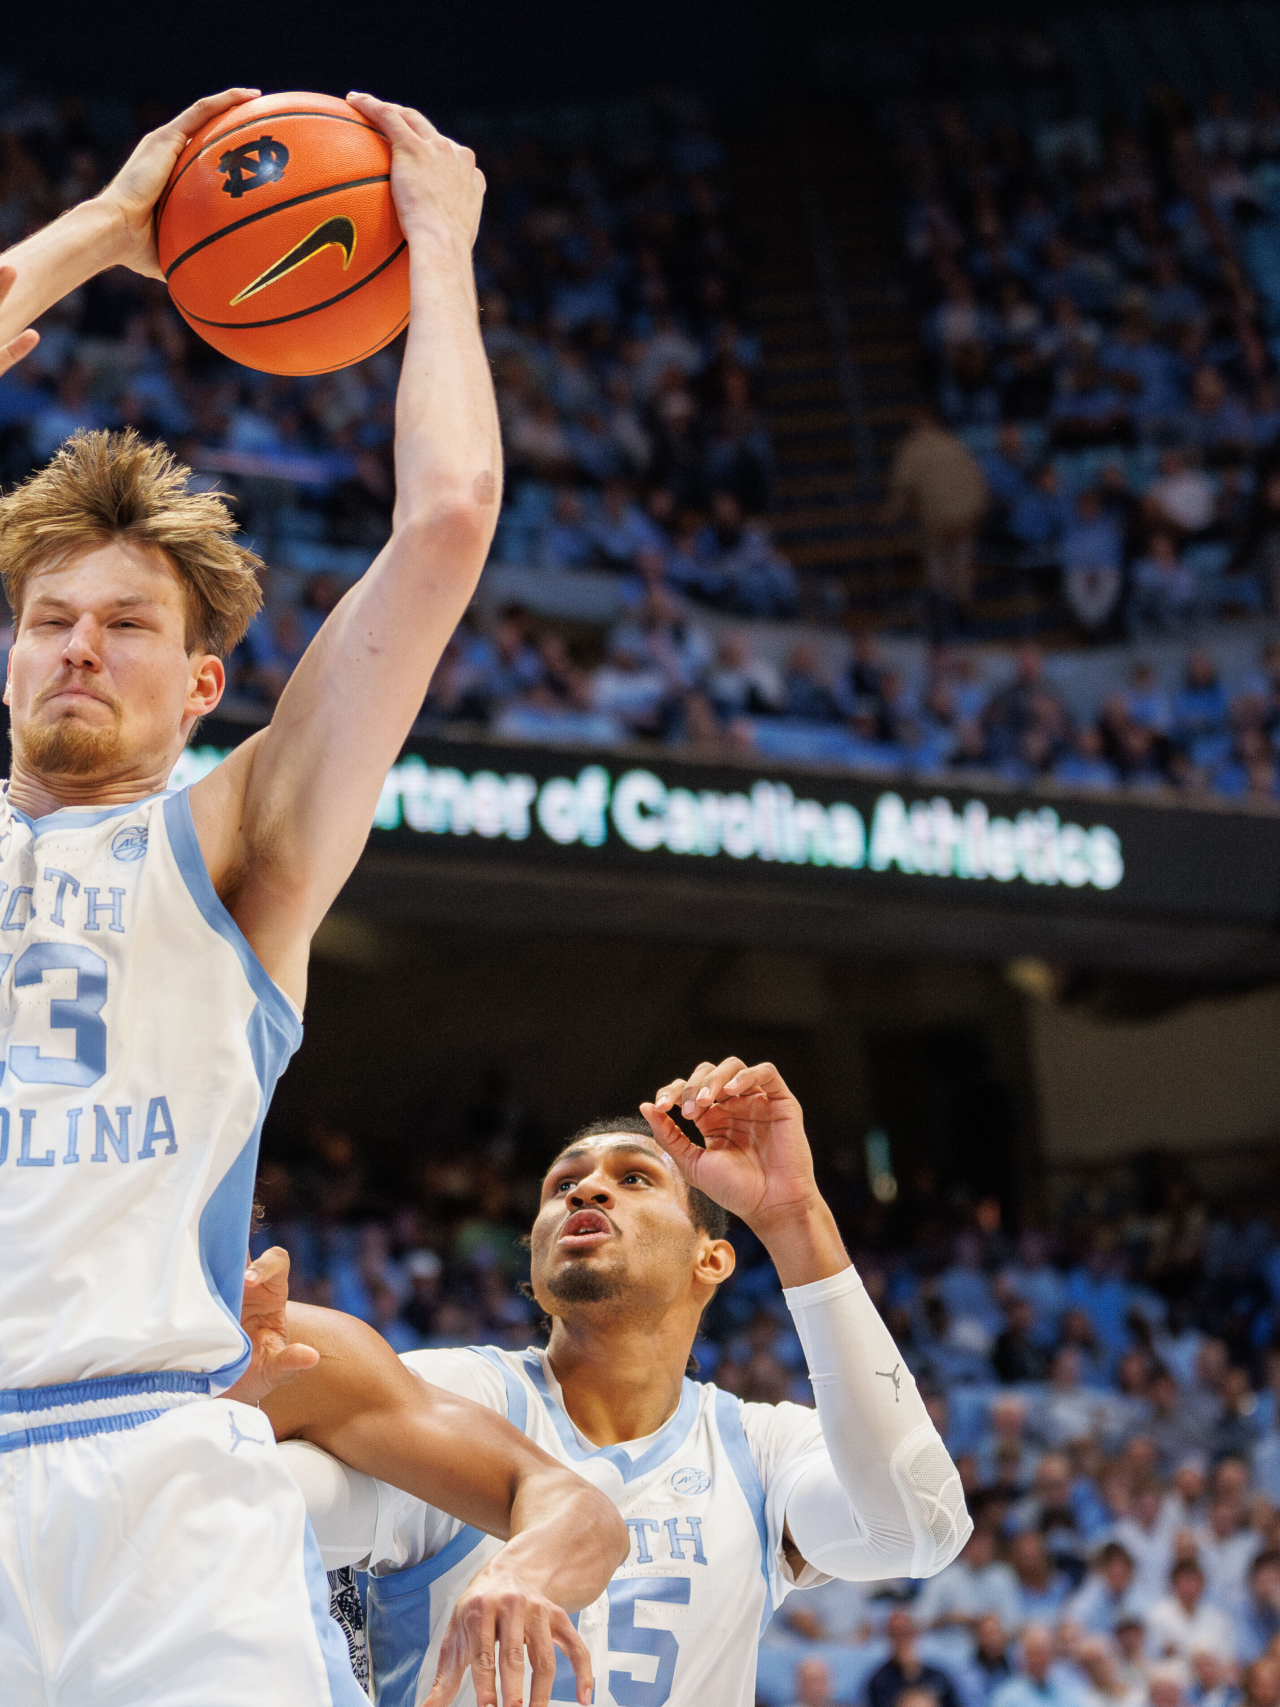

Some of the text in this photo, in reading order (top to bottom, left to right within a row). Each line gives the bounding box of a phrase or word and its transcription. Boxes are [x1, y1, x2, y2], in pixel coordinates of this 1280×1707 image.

[371, 753, 1124, 890] rtner of Carolina Athletics
